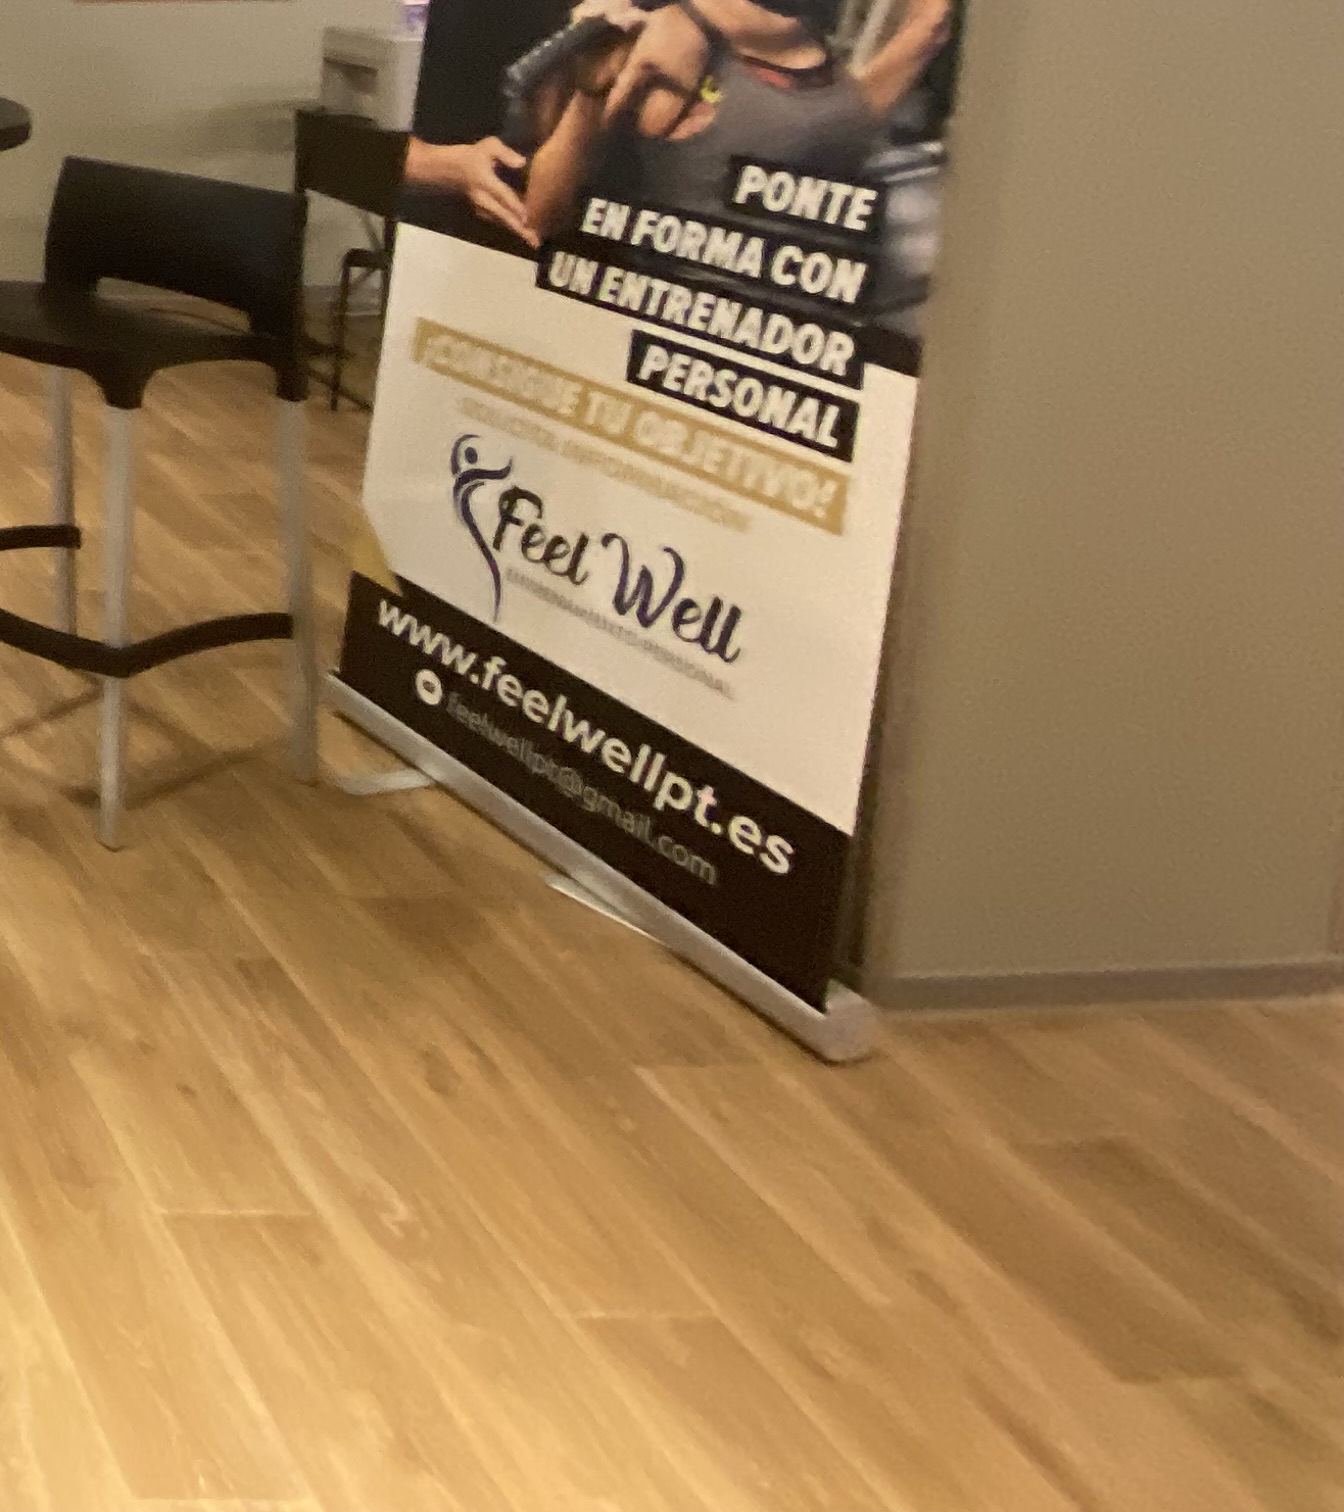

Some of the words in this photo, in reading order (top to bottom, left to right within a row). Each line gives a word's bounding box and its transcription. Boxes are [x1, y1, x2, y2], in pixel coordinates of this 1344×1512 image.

[581, 197, 631, 240] EN
[630, 209, 766, 278] FORMA
[770, 245, 867, 304] CON
[733, 165, 878, 231] PONTE
[548, 251, 599, 295] UN
[597, 266, 855, 376] ENTRENADOR
[583, 394, 634, 434] TU
[635, 410, 839, 519] OBJETIVO!
[637, 344, 841, 448] PERSONAL
[492, 486, 589, 585] Feel
[601, 533, 741, 663] Well
[377, 598, 794, 876] www.feelwellpt.es
